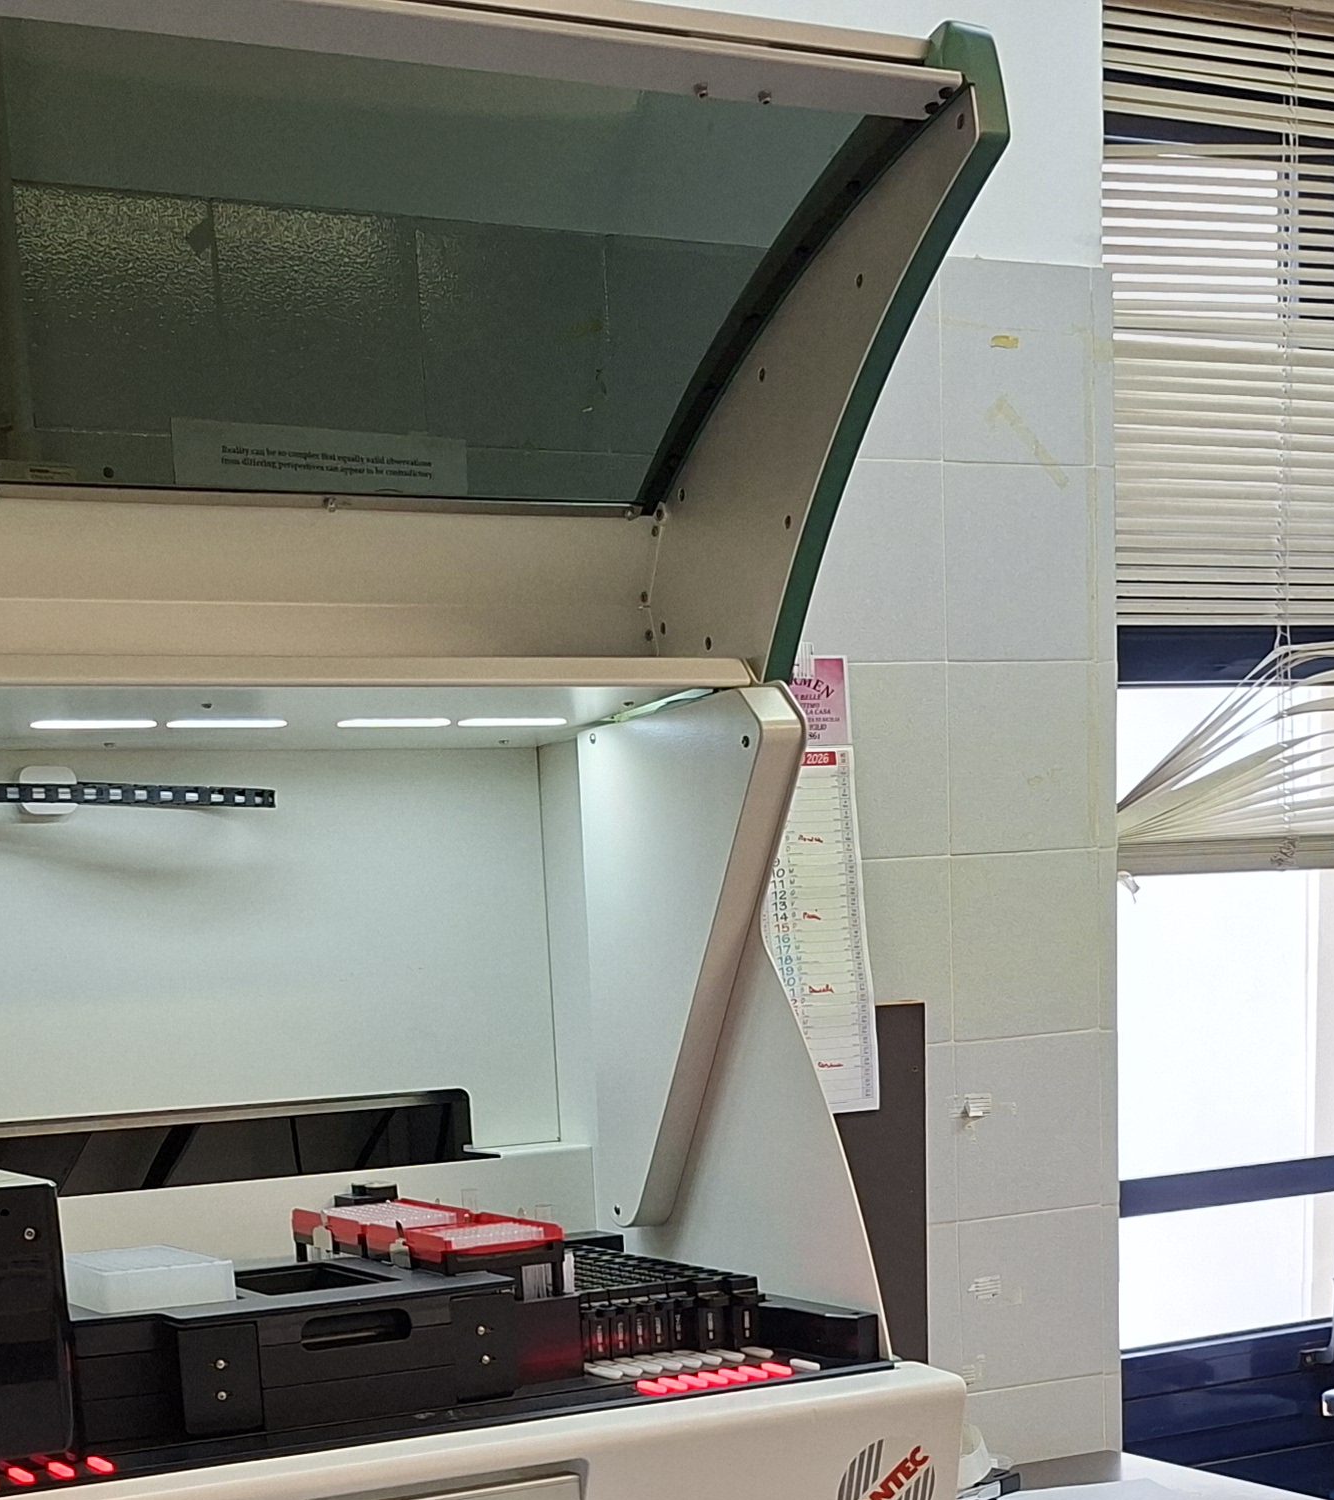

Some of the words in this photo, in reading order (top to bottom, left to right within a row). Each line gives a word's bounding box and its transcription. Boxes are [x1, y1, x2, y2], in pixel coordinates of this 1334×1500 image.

[222, 446, 249, 456] Reality
[338, 454, 364, 464] equally
[242, 458, 277, 468] differing
[807, 753, 829, 764] 2026
[771, 880, 784, 889] 11
[771, 890, 786, 900] 12
[772, 901, 787, 911] 13
[773, 913, 788, 921] 14
[774, 923, 790, 933] 15
[774, 934, 791, 944] 16
[777, 945, 791, 954] 17
[777, 955, 794, 965] 18
[779, 966, 794, 975] 19
